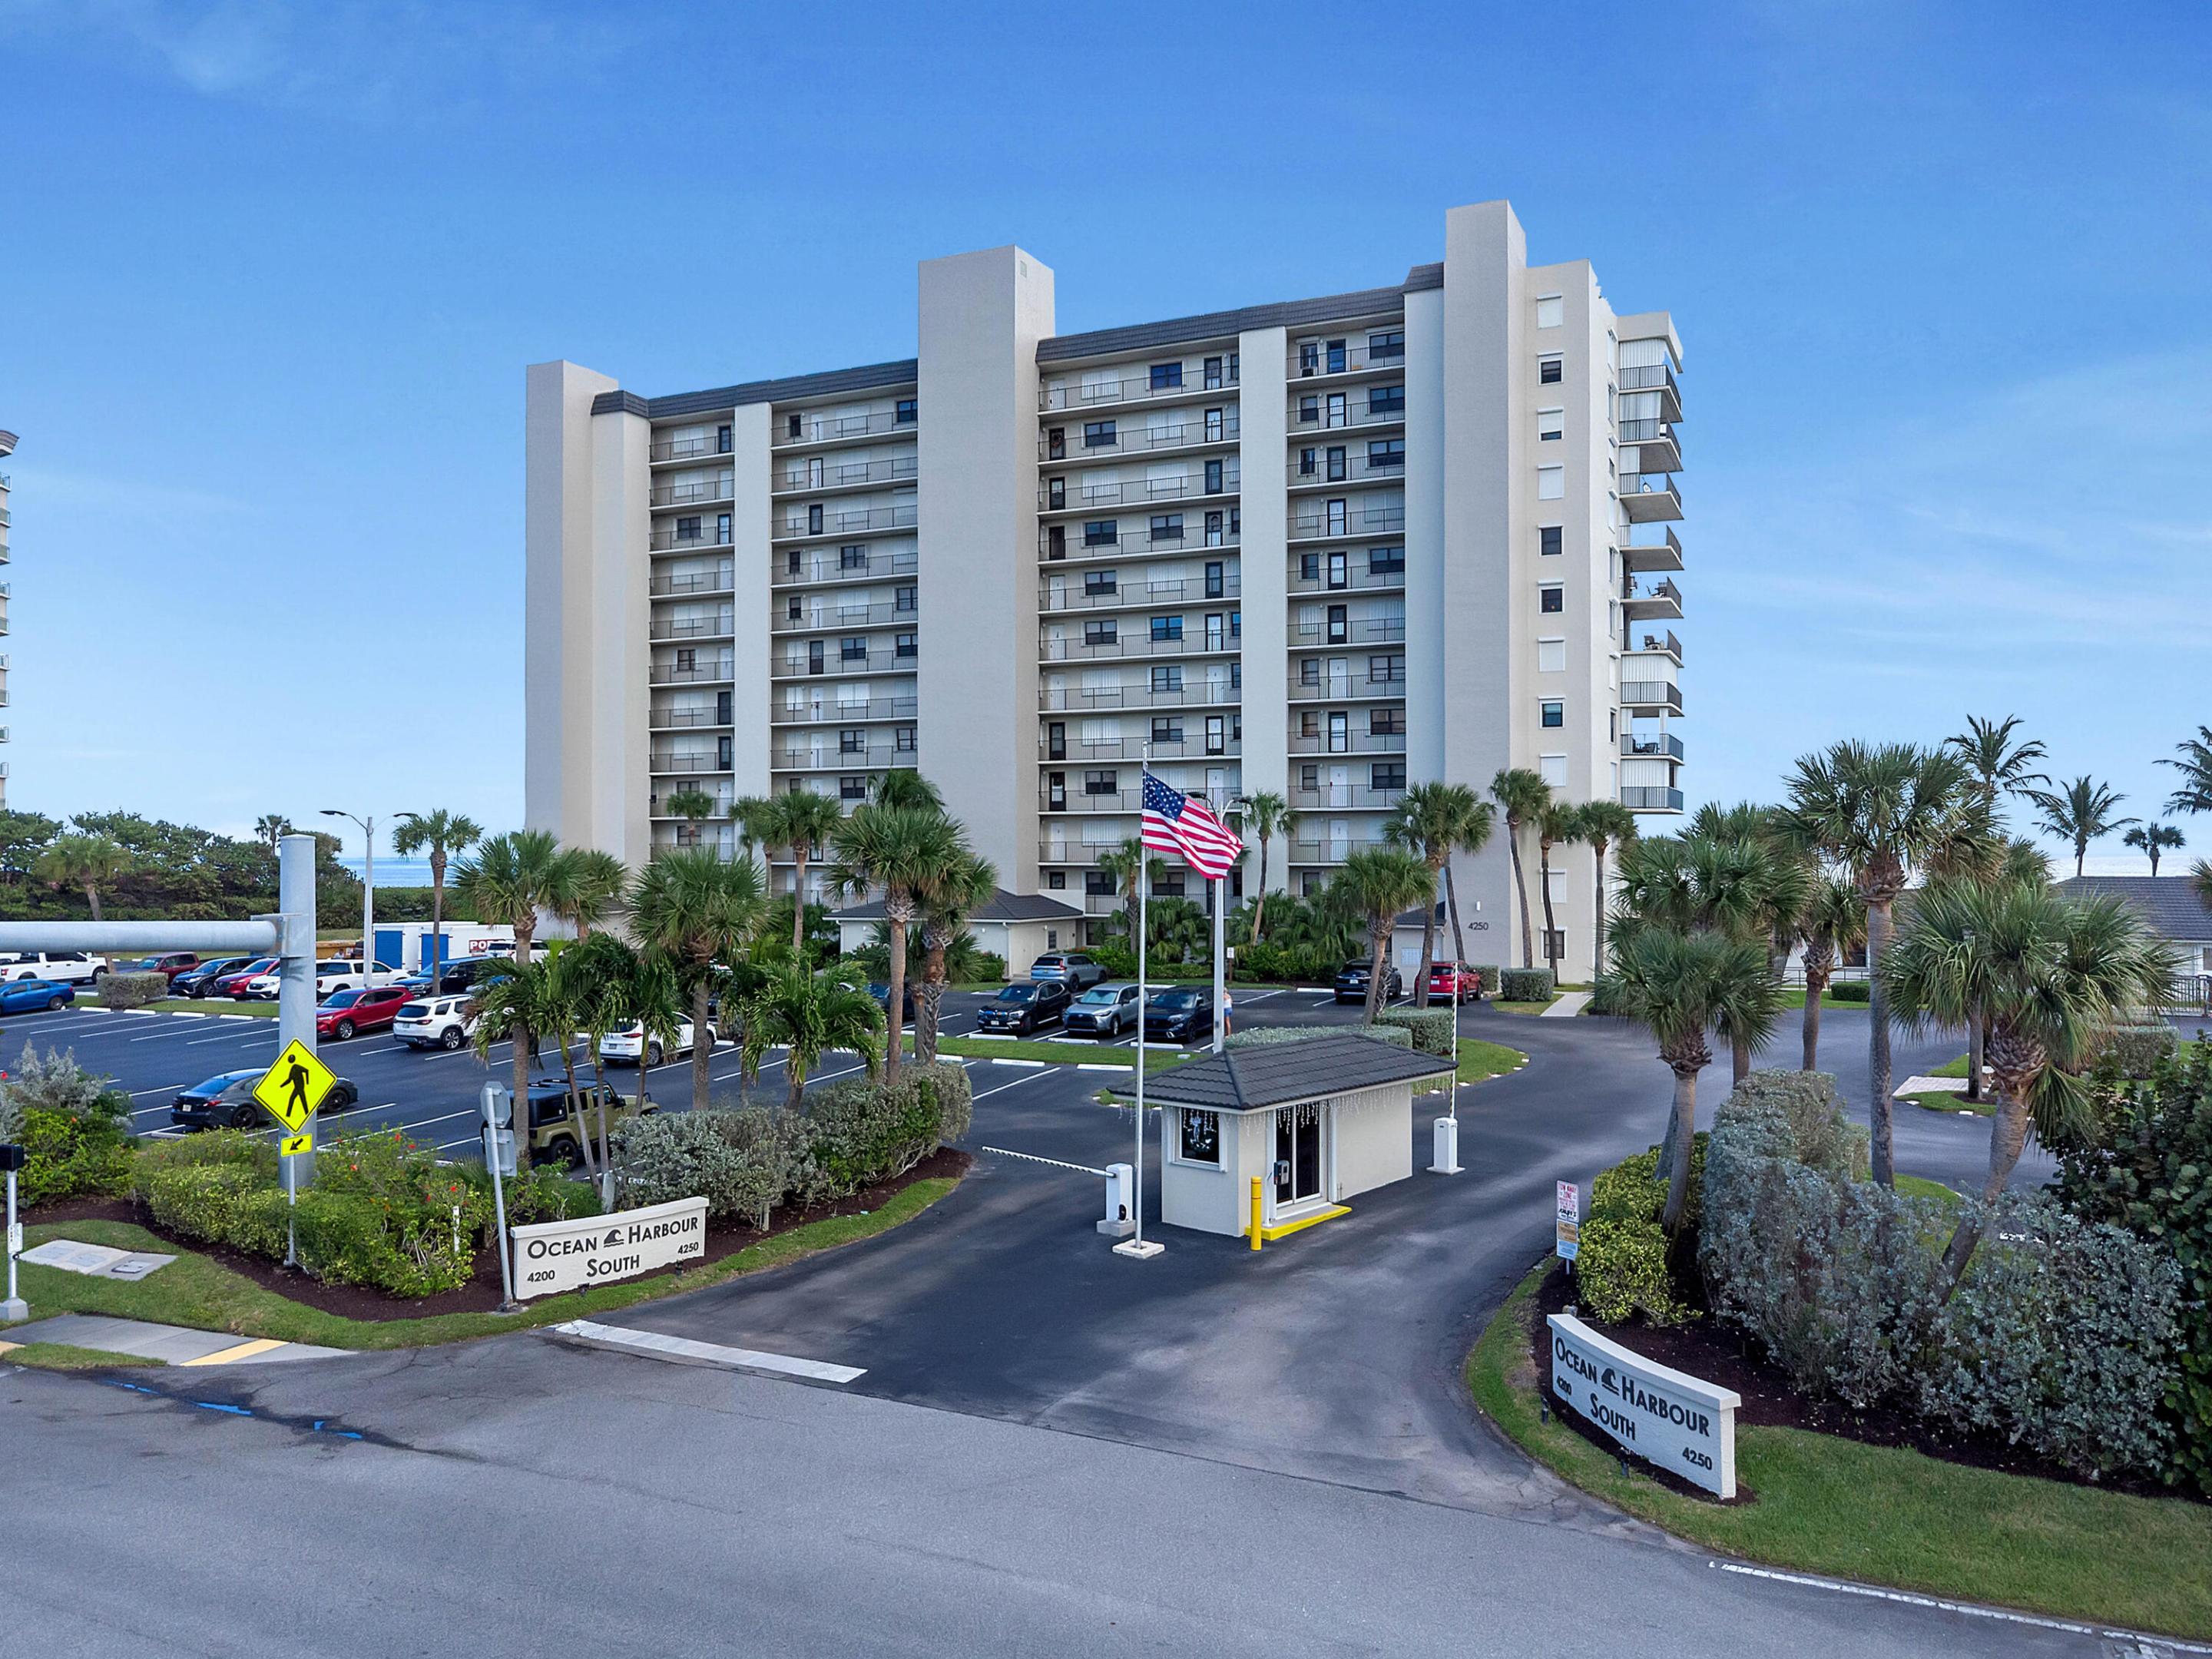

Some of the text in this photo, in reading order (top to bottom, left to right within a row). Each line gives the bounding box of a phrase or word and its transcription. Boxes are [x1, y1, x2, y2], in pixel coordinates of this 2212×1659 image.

[1468, 922, 1489, 930] 4250
[527, 1217, 698, 1260] OCEAN HARBOUR
[677, 1241, 699, 1255] 4250
[527, 1270, 555, 1283] 4200
[586, 1254, 640, 1277] SOUTH
[1555, 1337, 1710, 1437] OCEAN HARBOUR
[1556, 1375, 1572, 1396] 4200
[1590, 1393, 1636, 1441] SOUTH
[1682, 1447, 1714, 1471] 4250
